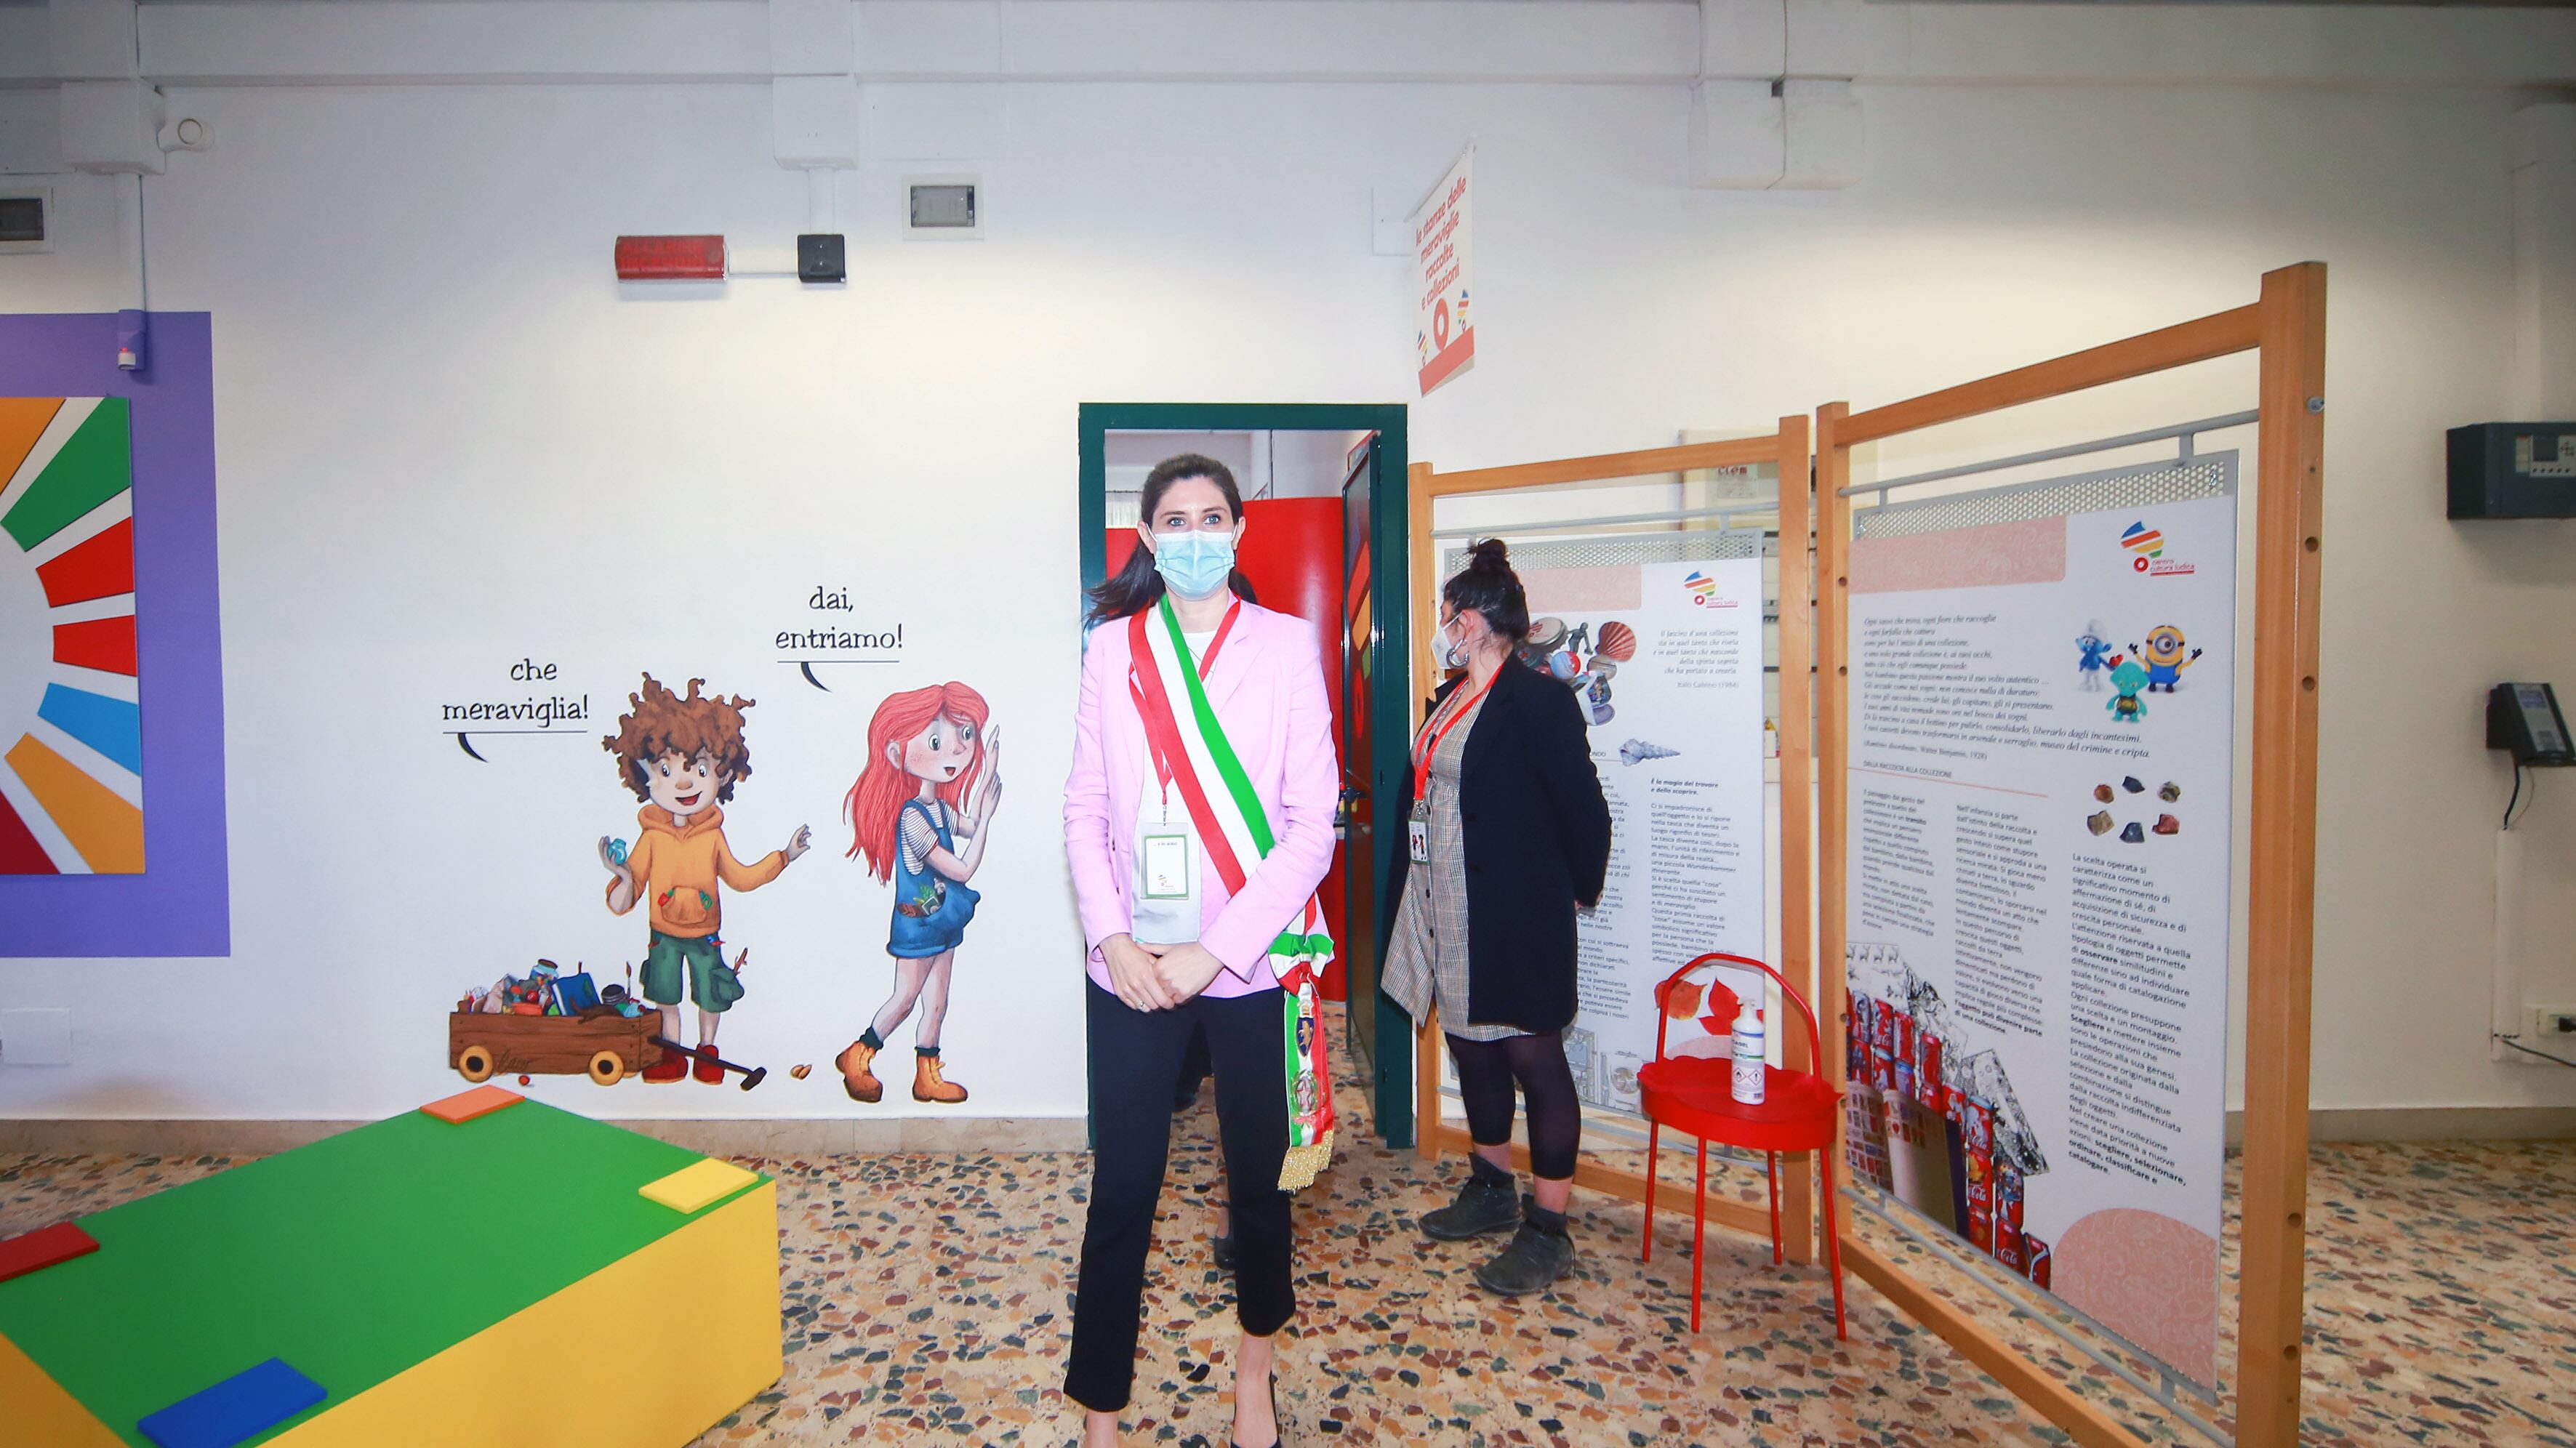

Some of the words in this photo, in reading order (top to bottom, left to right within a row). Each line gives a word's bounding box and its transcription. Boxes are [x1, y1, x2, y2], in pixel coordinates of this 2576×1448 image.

[1416, 228, 1422, 248] le
[1423, 201, 1446, 238] stanze
[1447, 176, 1466, 210] delle
[1421, 209, 1459, 264] meraviglie
[1426, 243, 1453, 283] raccolte
[1421, 297, 1426, 311] e
[1427, 256, 1459, 305] collezioni
[808, 586, 854, 613] dai,
[775, 624, 903, 650] entriamo!
[510, 658, 558, 681] che
[1988, 674, 2005, 683] volto
[442, 695, 589, 728] meraviglia!
[2033, 726, 2066, 737] liberarlo
[2068, 729, 2088, 740] dagli
[2066, 741, 2079, 751] del
[2081, 744, 2112, 754] crimine
[2122, 747, 2151, 759] cripta.
[2073, 852, 2081, 861] La
[2083, 856, 2104, 866] scelta
[2107, 861, 2138, 872] operata
[2140, 865, 2146, 874] si
[2073, 866, 2116, 880] caratterizza
[2118, 874, 2140, 885] come
[2072, 888, 2122, 906] affermazione
[2124, 898, 2132, 908] di
[2148, 903, 2156, 913] di
[2073, 876, 2117, 893] significativo
[2119, 887, 2159, 901] momento
[2162, 893, 2170, 904] di
[2072, 901, 2118, 917] acquisizione
[2120, 909, 2128, 919] di
[2130, 912, 2167, 928] sicurezza
[2178, 922, 2186, 932] di
[2072, 912, 2100, 925] crescita
[2071, 944, 2078, 954] di
[2080, 949, 2117, 965] osservare
[2120, 958, 2165, 977] similitudini
[2072, 933, 2104, 949] tipologia
[2106, 941, 2114, 952] di
[2116, 946, 2143, 960] oggetti
[2146, 954, 2186, 970] permette
[2119, 933, 2154, 950] riservata
[2164, 946, 2191, 960] quella
[2071, 955, 2108, 974] differenze
[2111, 968, 2127, 979] sino
[2129, 973, 2139, 983] ad
[2141, 976, 2189, 997] individuare
[2071, 970, 2091, 981] quale
[2094, 973, 2116, 989] forma
[2119, 981, 2126, 992] di
[2129, 986, 2186, 1008] catalogazione
[2071, 989, 2088, 1003] Ogni
[2090, 998, 2128, 1015] collezione
[2131, 1010, 2181, 1032] presuppone
[2071, 1004, 2085, 1014] una
[2087, 1009, 2108, 1021] scelta
[2117, 1018, 2127, 1028] un
[2071, 1012, 2104, 1031] Scegliere
[2114, 1029, 2146, 1045] mettere
[2148, 1038, 2181, 1058] insieme
[2071, 1026, 2088, 1038] sono
[2090, 1031, 2097, 1041] le
[2099, 1036, 2140, 1055] operazioni
[2143, 1050, 2157, 1061] che
[2070, 1046, 2078, 1057] La
[2080, 1053, 2118, 1072] collezione
[2120, 1067, 2156, 1086] originata
[2159, 1079, 2179, 1094] dalla
[2071, 1038, 2112, 1058] presiedono
[2114, 1053, 2128, 1064] alla
[2130, 1059, 2144, 1070] sua
[2070, 1061, 2104, 1079] selezione
[2114, 1074, 2132, 1089] dalla
[2069, 1092, 2087, 1108] degli
[2070, 1072, 2122, 1098] combinazione
[2124, 1092, 2130, 1101] si
[2132, 1093, 2171, 1115] distingue
[2070, 1080, 2087, 1095] dalla
[2089, 1090, 2119, 1109] raccolta
[2122, 1101, 2181, 1133] indifferenziata
[2069, 1103, 2082, 1117] Nel
[2084, 1111, 2107, 1127] creare
[2109, 1122, 2124, 1134] una
[2126, 1129, 2167, 1151] collezione
[2069, 1117, 2088, 1131] viene
[2091, 1124, 2108, 1139] data
[2148, 1151, 2175, 1167] nuove
[2069, 1140, 2103, 1162] ordinare,
[2106, 1155, 2150, 1181] classificare
[2095, 1140, 2132, 1165] scegliere,
[2135, 1157, 2186, 1188] selezionare,
